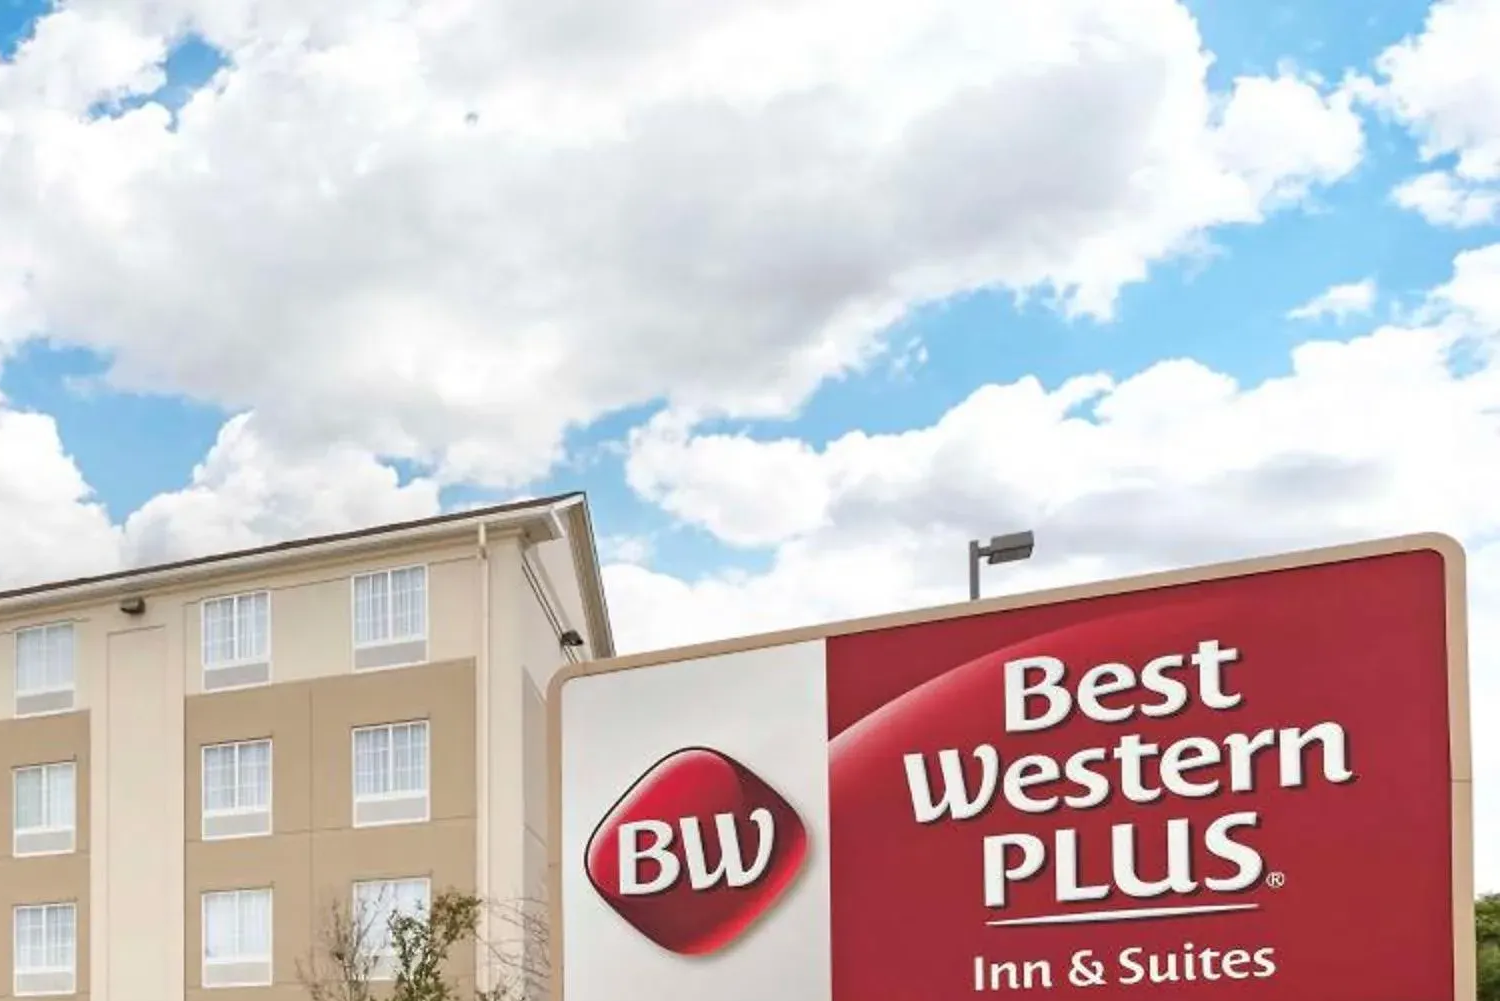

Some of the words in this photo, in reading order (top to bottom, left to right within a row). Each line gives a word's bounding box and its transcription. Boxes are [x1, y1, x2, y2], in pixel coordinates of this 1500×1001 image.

[1004, 639, 1242, 732] Best
[903, 721, 1354, 824] Western
[618, 807, 775, 896] BW
[974, 956, 1054, 991] Inn
[1068, 949, 1108, 987] &
[1119, 942, 1277, 985] Suites
